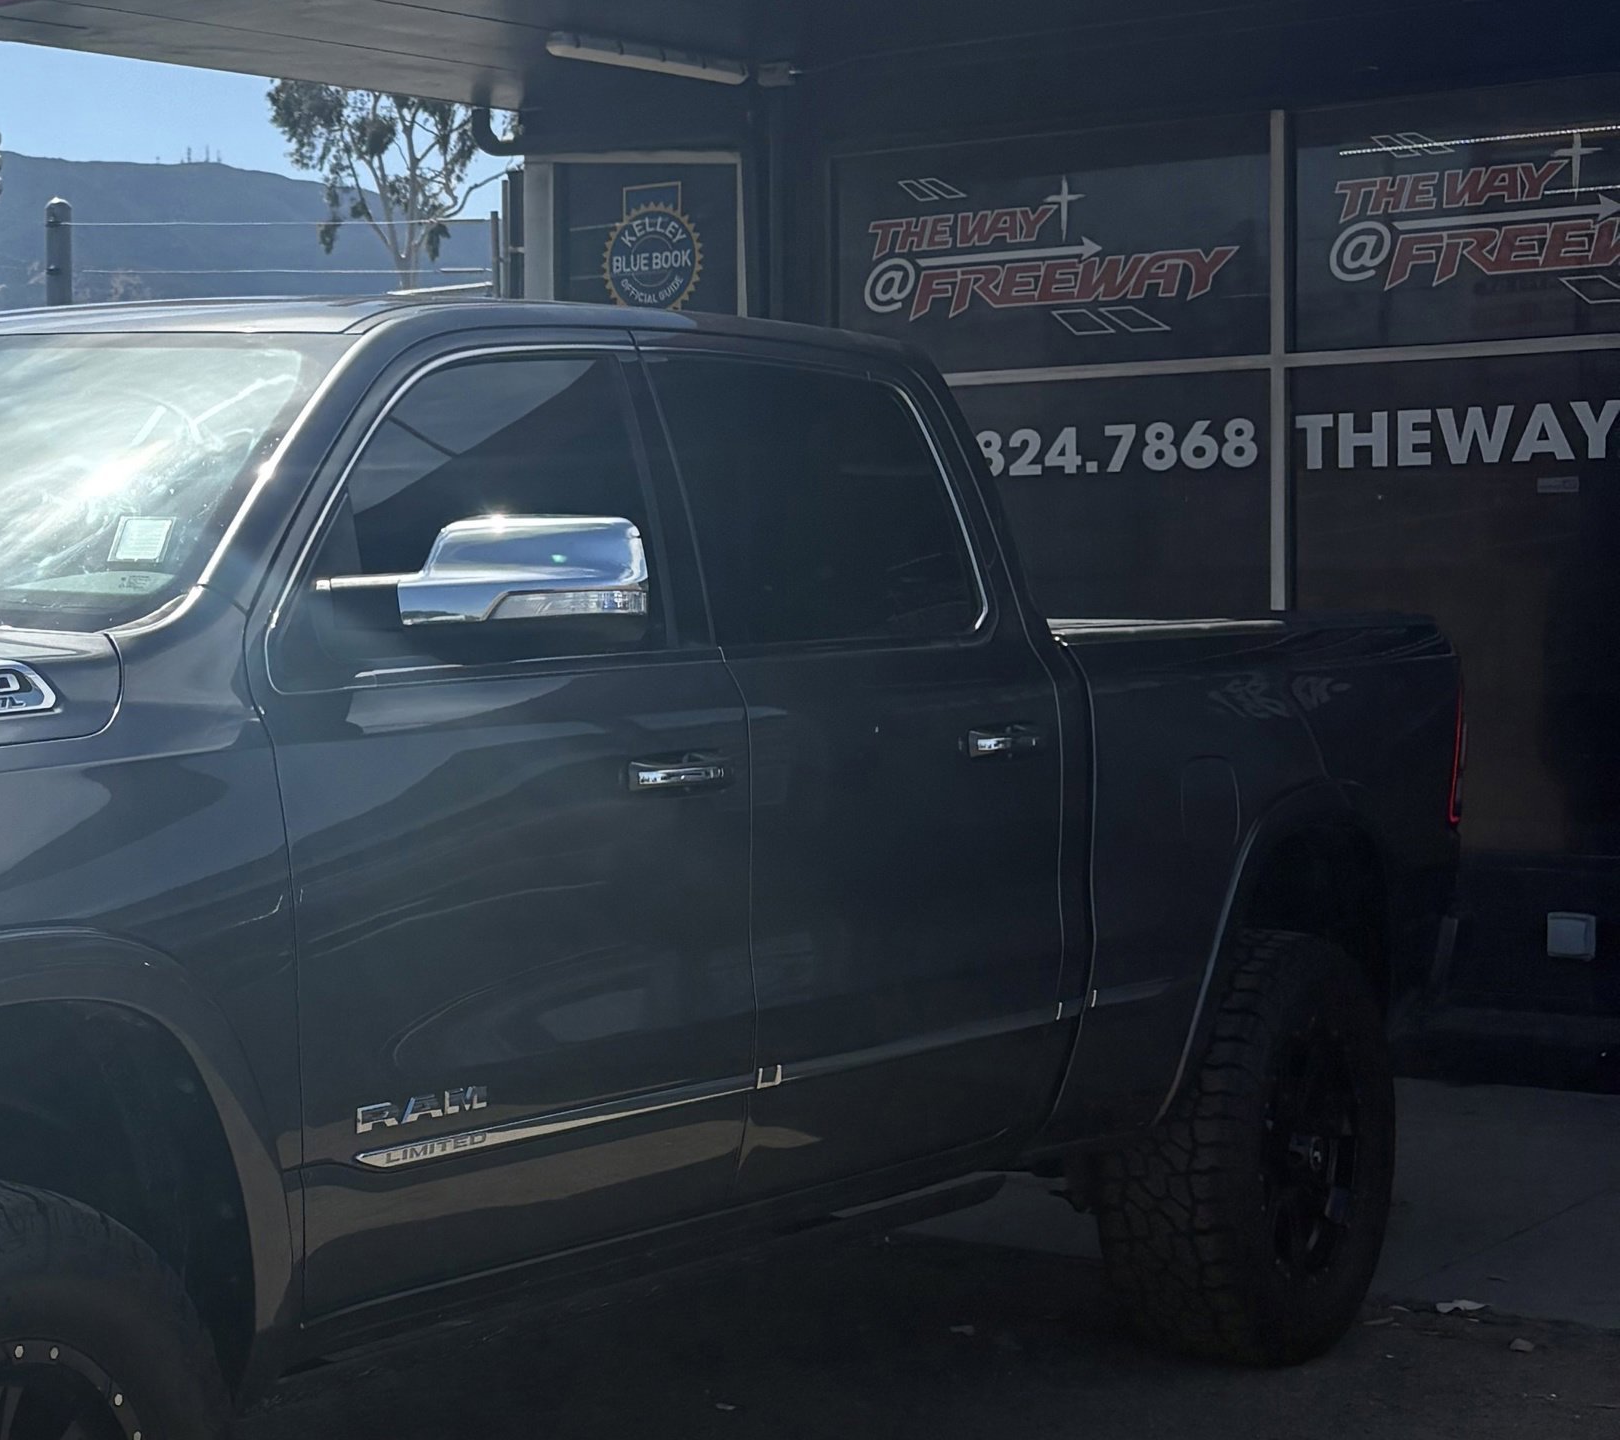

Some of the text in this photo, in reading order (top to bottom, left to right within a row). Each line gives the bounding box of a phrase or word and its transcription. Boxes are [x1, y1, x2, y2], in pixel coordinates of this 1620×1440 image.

[621, 217, 686, 248] KELLEY
[612, 248, 691, 274] BLUE BOOK
[621, 274, 684, 304] OFFICIAL GUIDE
[1295, 400, 1620, 469] THEWAY
[356, 1085, 487, 1134] RAM
[385, 1132, 487, 1163] LIMITED
